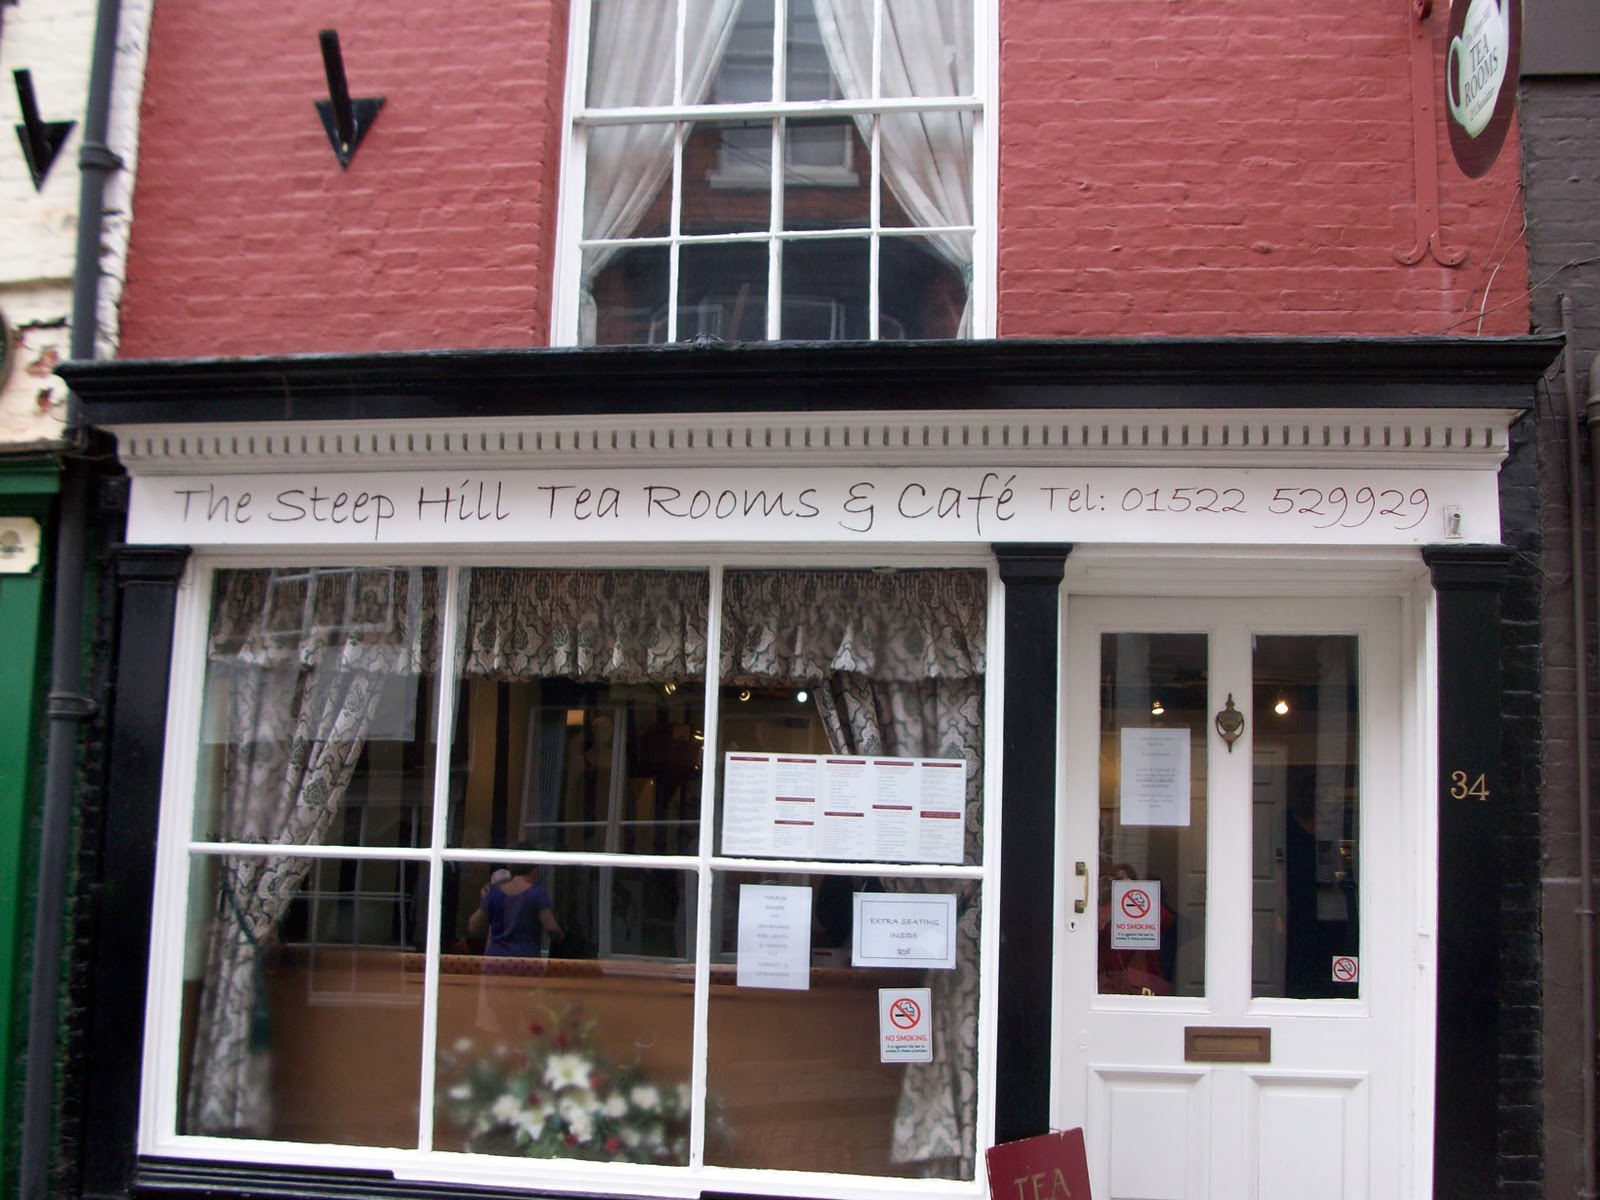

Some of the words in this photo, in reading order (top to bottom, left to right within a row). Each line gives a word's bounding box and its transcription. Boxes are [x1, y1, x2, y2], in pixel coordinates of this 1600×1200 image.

[1470, 33, 1490, 71] TEA
[1464, 47, 1499, 108] ROOMS
[174, 484, 251, 524] The
[268, 486, 394, 540] Steep
[418, 479, 510, 524] Hill
[537, 485, 620, 521] Tea
[643, 485, 820, 520] Rooms
[839, 481, 876, 532] &
[897, 473, 1016, 536] Café
[1040, 484, 1105, 513] Tel:
[1121, 487, 1247, 514] 01522
[1268, 487, 1430, 530] 529929
[1451, 771, 1490, 801] 34
[869, 917, 899, 925] EXTRA
[900, 918, 940, 927] SEATING
[889, 932, 919, 940] INSIDE
[1014, 1168, 1072, 1200] TEA
